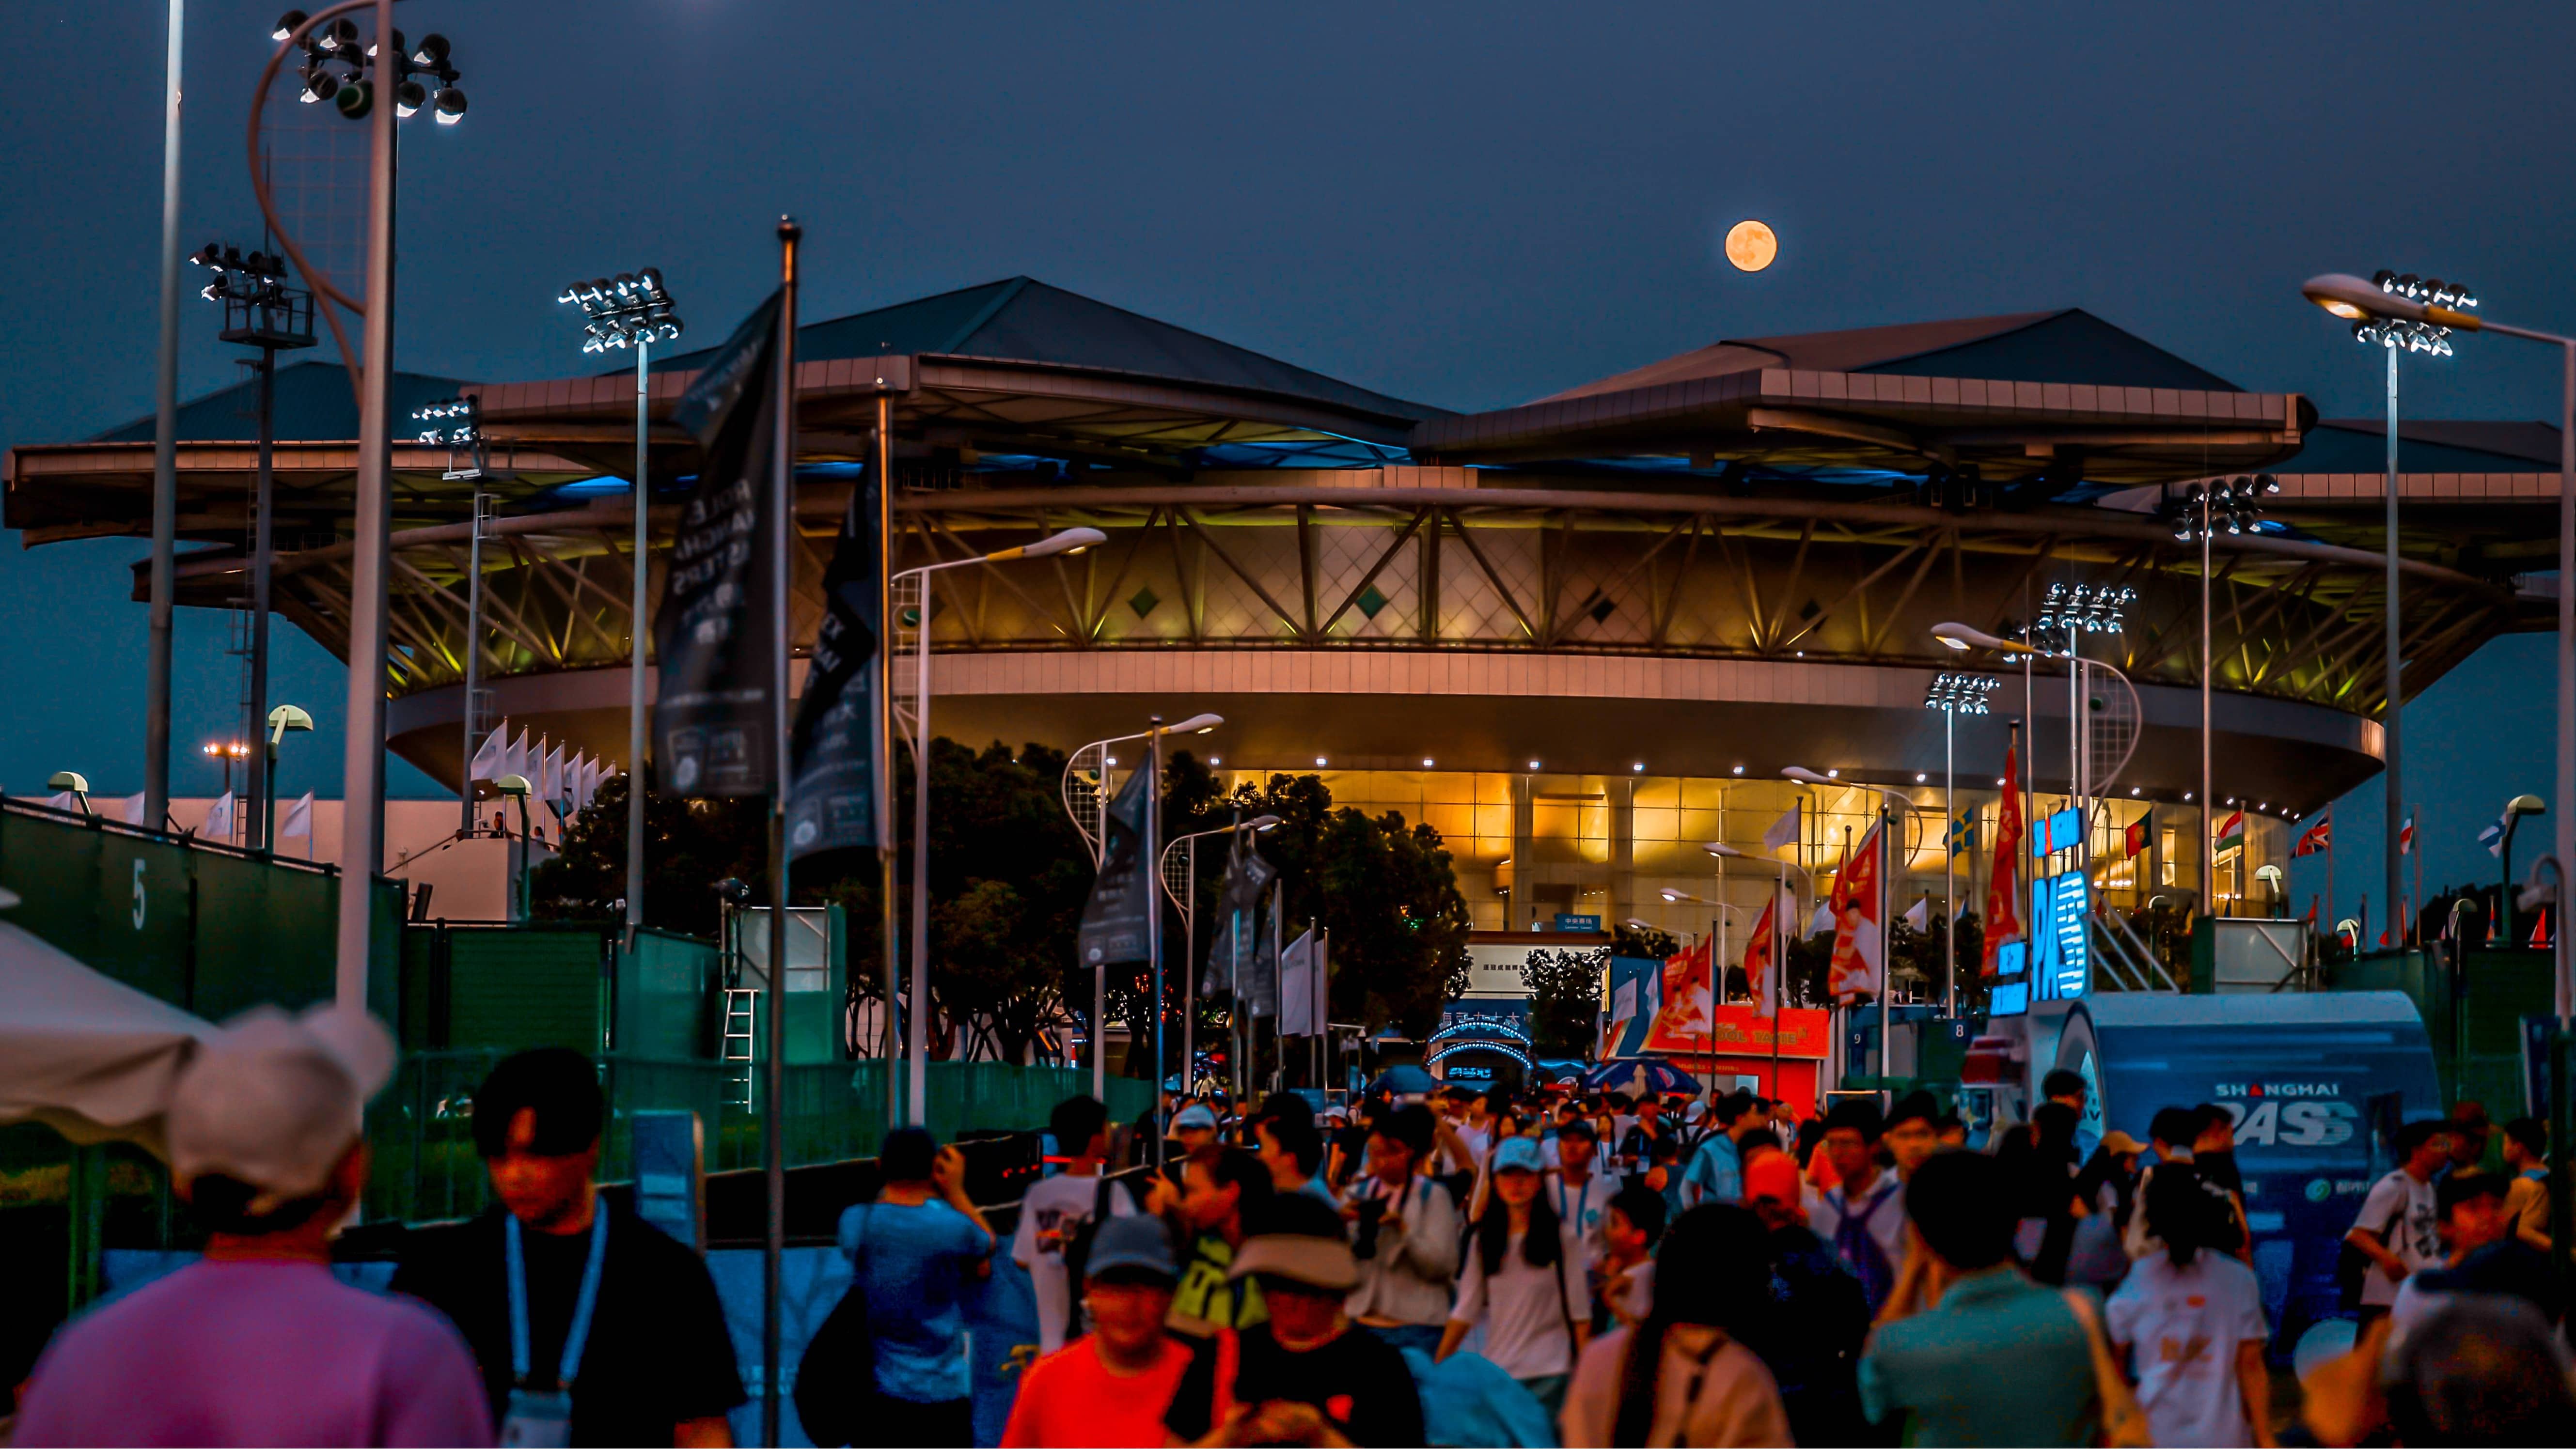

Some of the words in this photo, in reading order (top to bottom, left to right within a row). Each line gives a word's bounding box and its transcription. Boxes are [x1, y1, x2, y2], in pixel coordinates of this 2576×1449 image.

[133, 858, 145, 930] 5
[1752, 1030, 1796, 1044] TATE
[1956, 1024, 1963, 1037] 8
[1854, 1033, 1861, 1044] 9
[2215, 1083, 2339, 1097] SHANGHAI
